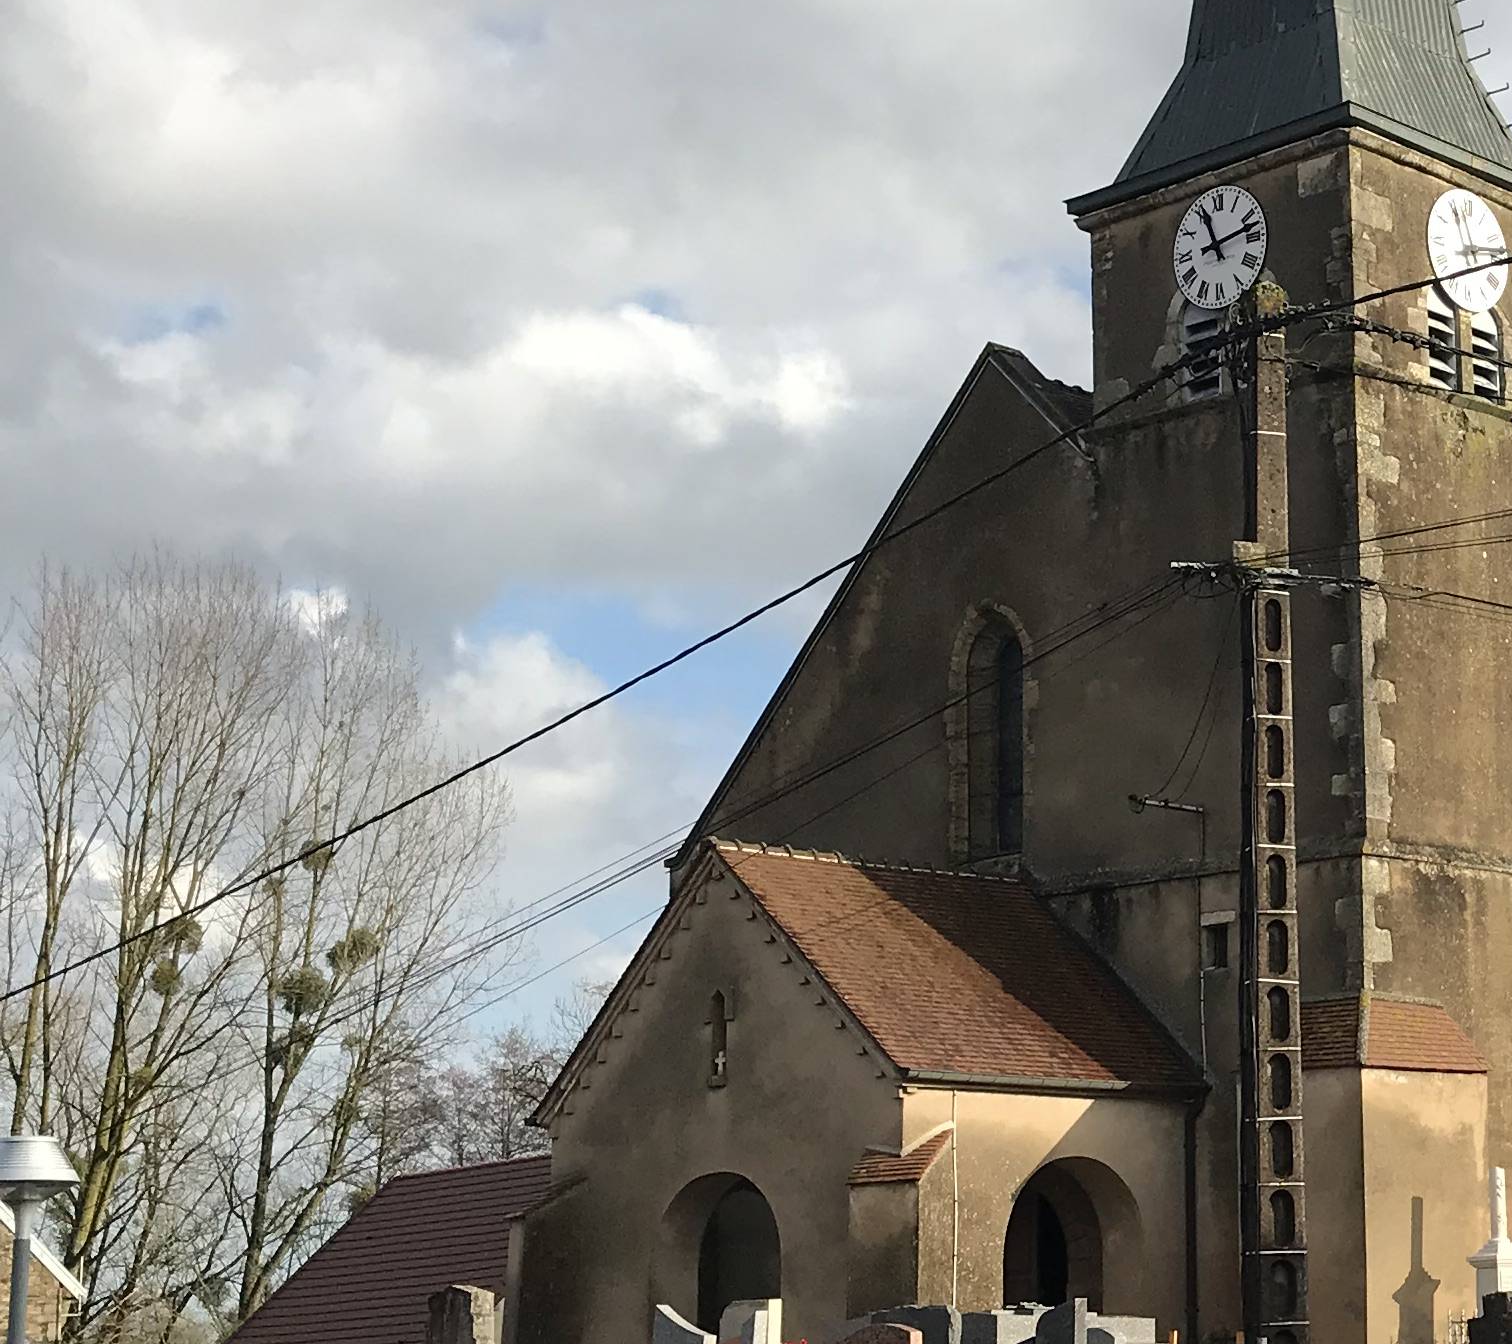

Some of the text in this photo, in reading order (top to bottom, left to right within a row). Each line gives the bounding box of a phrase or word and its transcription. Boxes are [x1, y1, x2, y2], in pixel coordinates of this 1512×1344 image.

[1212, 193, 1224, 214] XII
[1230, 195, 1240, 213] I
[1241, 208, 1256, 224] II
[1182, 227, 1197, 240] X
[1246, 230, 1261, 244] III
[1178, 249, 1193, 265] IX
[1241, 251, 1259, 271] IIII
[1182, 265, 1199, 289] VIII
[1233, 273, 1245, 290] V
[1197, 280, 1210, 301] VII
[1215, 282, 1226, 301] VI
